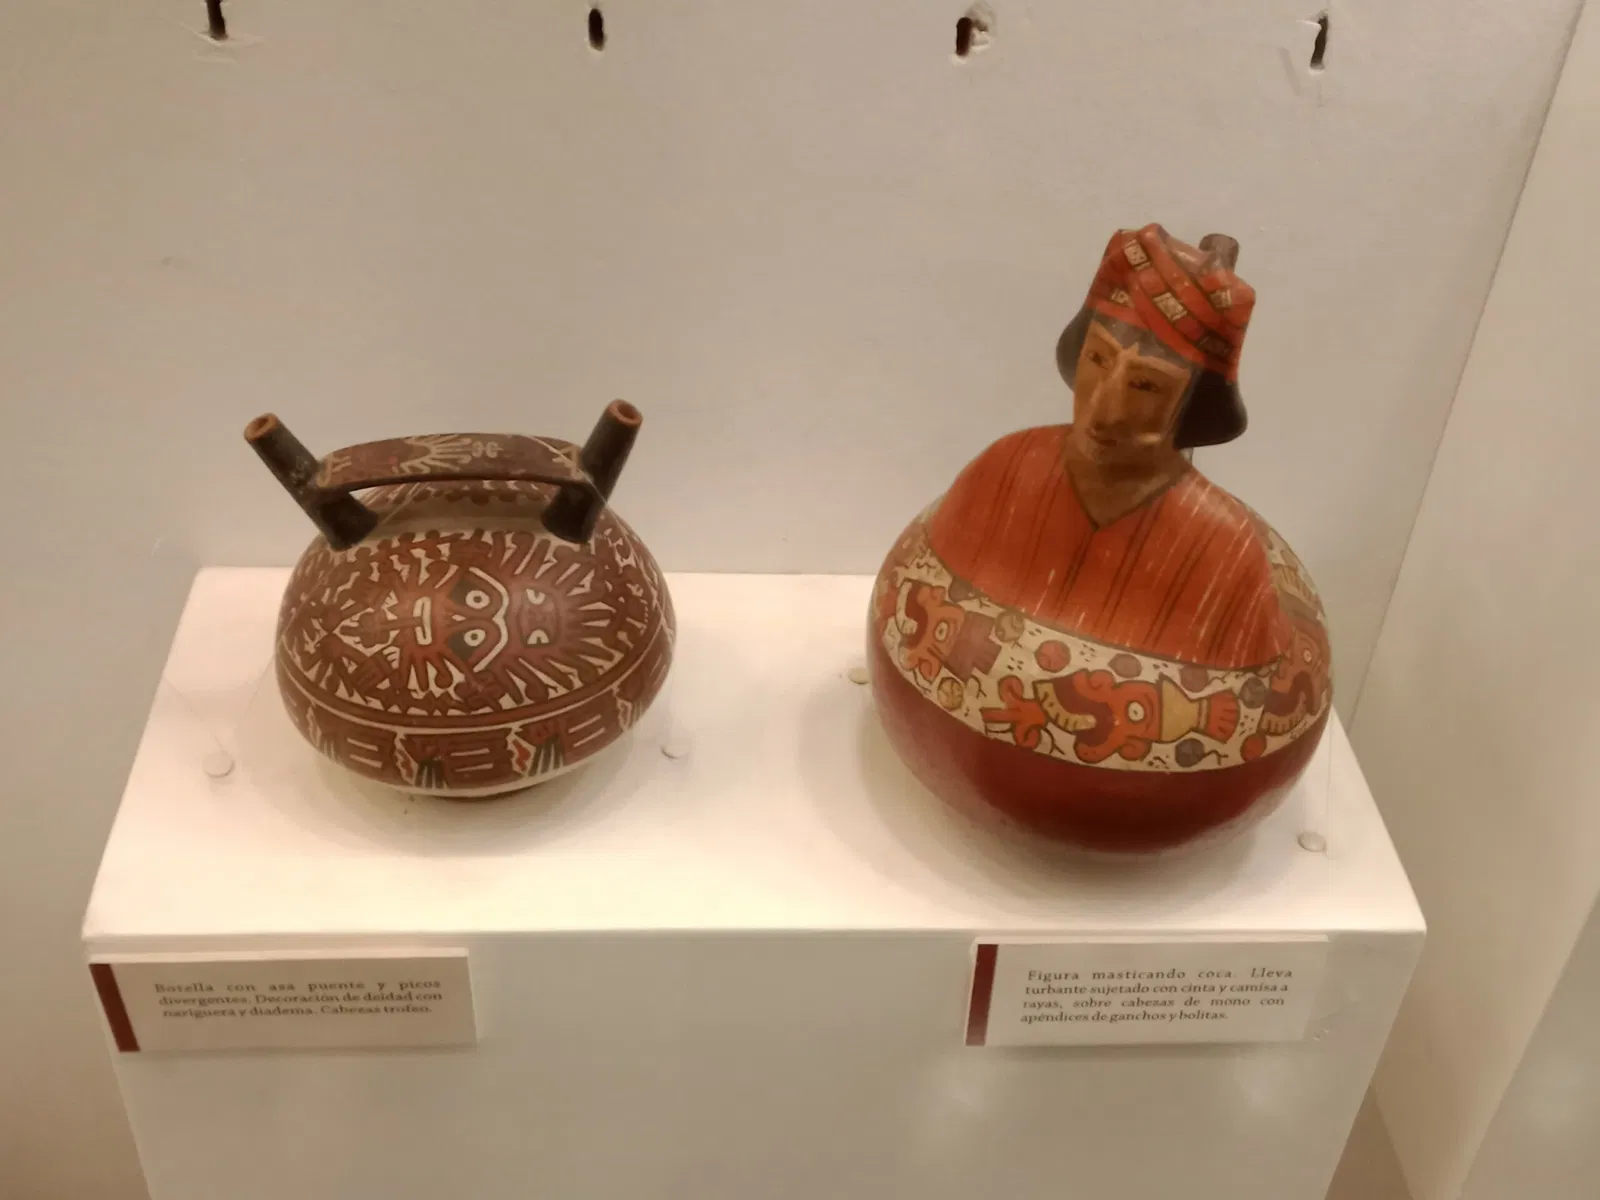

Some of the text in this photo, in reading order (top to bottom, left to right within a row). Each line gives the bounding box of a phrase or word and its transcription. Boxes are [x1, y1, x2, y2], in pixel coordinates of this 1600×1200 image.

[1028, 970, 1079, 982] Figura
[1092, 968, 1186, 980] masticando
[1250, 968, 1293, 978] Lleva
[226, 984, 256, 992] con
[268, 984, 296, 992] asa
[307, 982, 365, 992] puente
[377, 982, 385, 990] y
[398, 981, 441, 991] picos
[1025, 982, 1288, 995] turbante sujetado con cinta y camisa a
[342, 992, 360, 1001] de
[415, 993, 442, 1001] con
[1072, 997, 1112, 1008] sobre
[1121, 997, 1175, 1008] cabezas
[1183, 996, 1201, 1007] de
[1210, 998, 1251, 1006] mono
[1259, 998, 1284, 1006] con
[239, 1009, 247, 1017] y
[1091, 1011, 1109, 1021] de
[1109, 1010, 1167, 1023] ganchos
[1168, 1012, 1177, 1022] y
